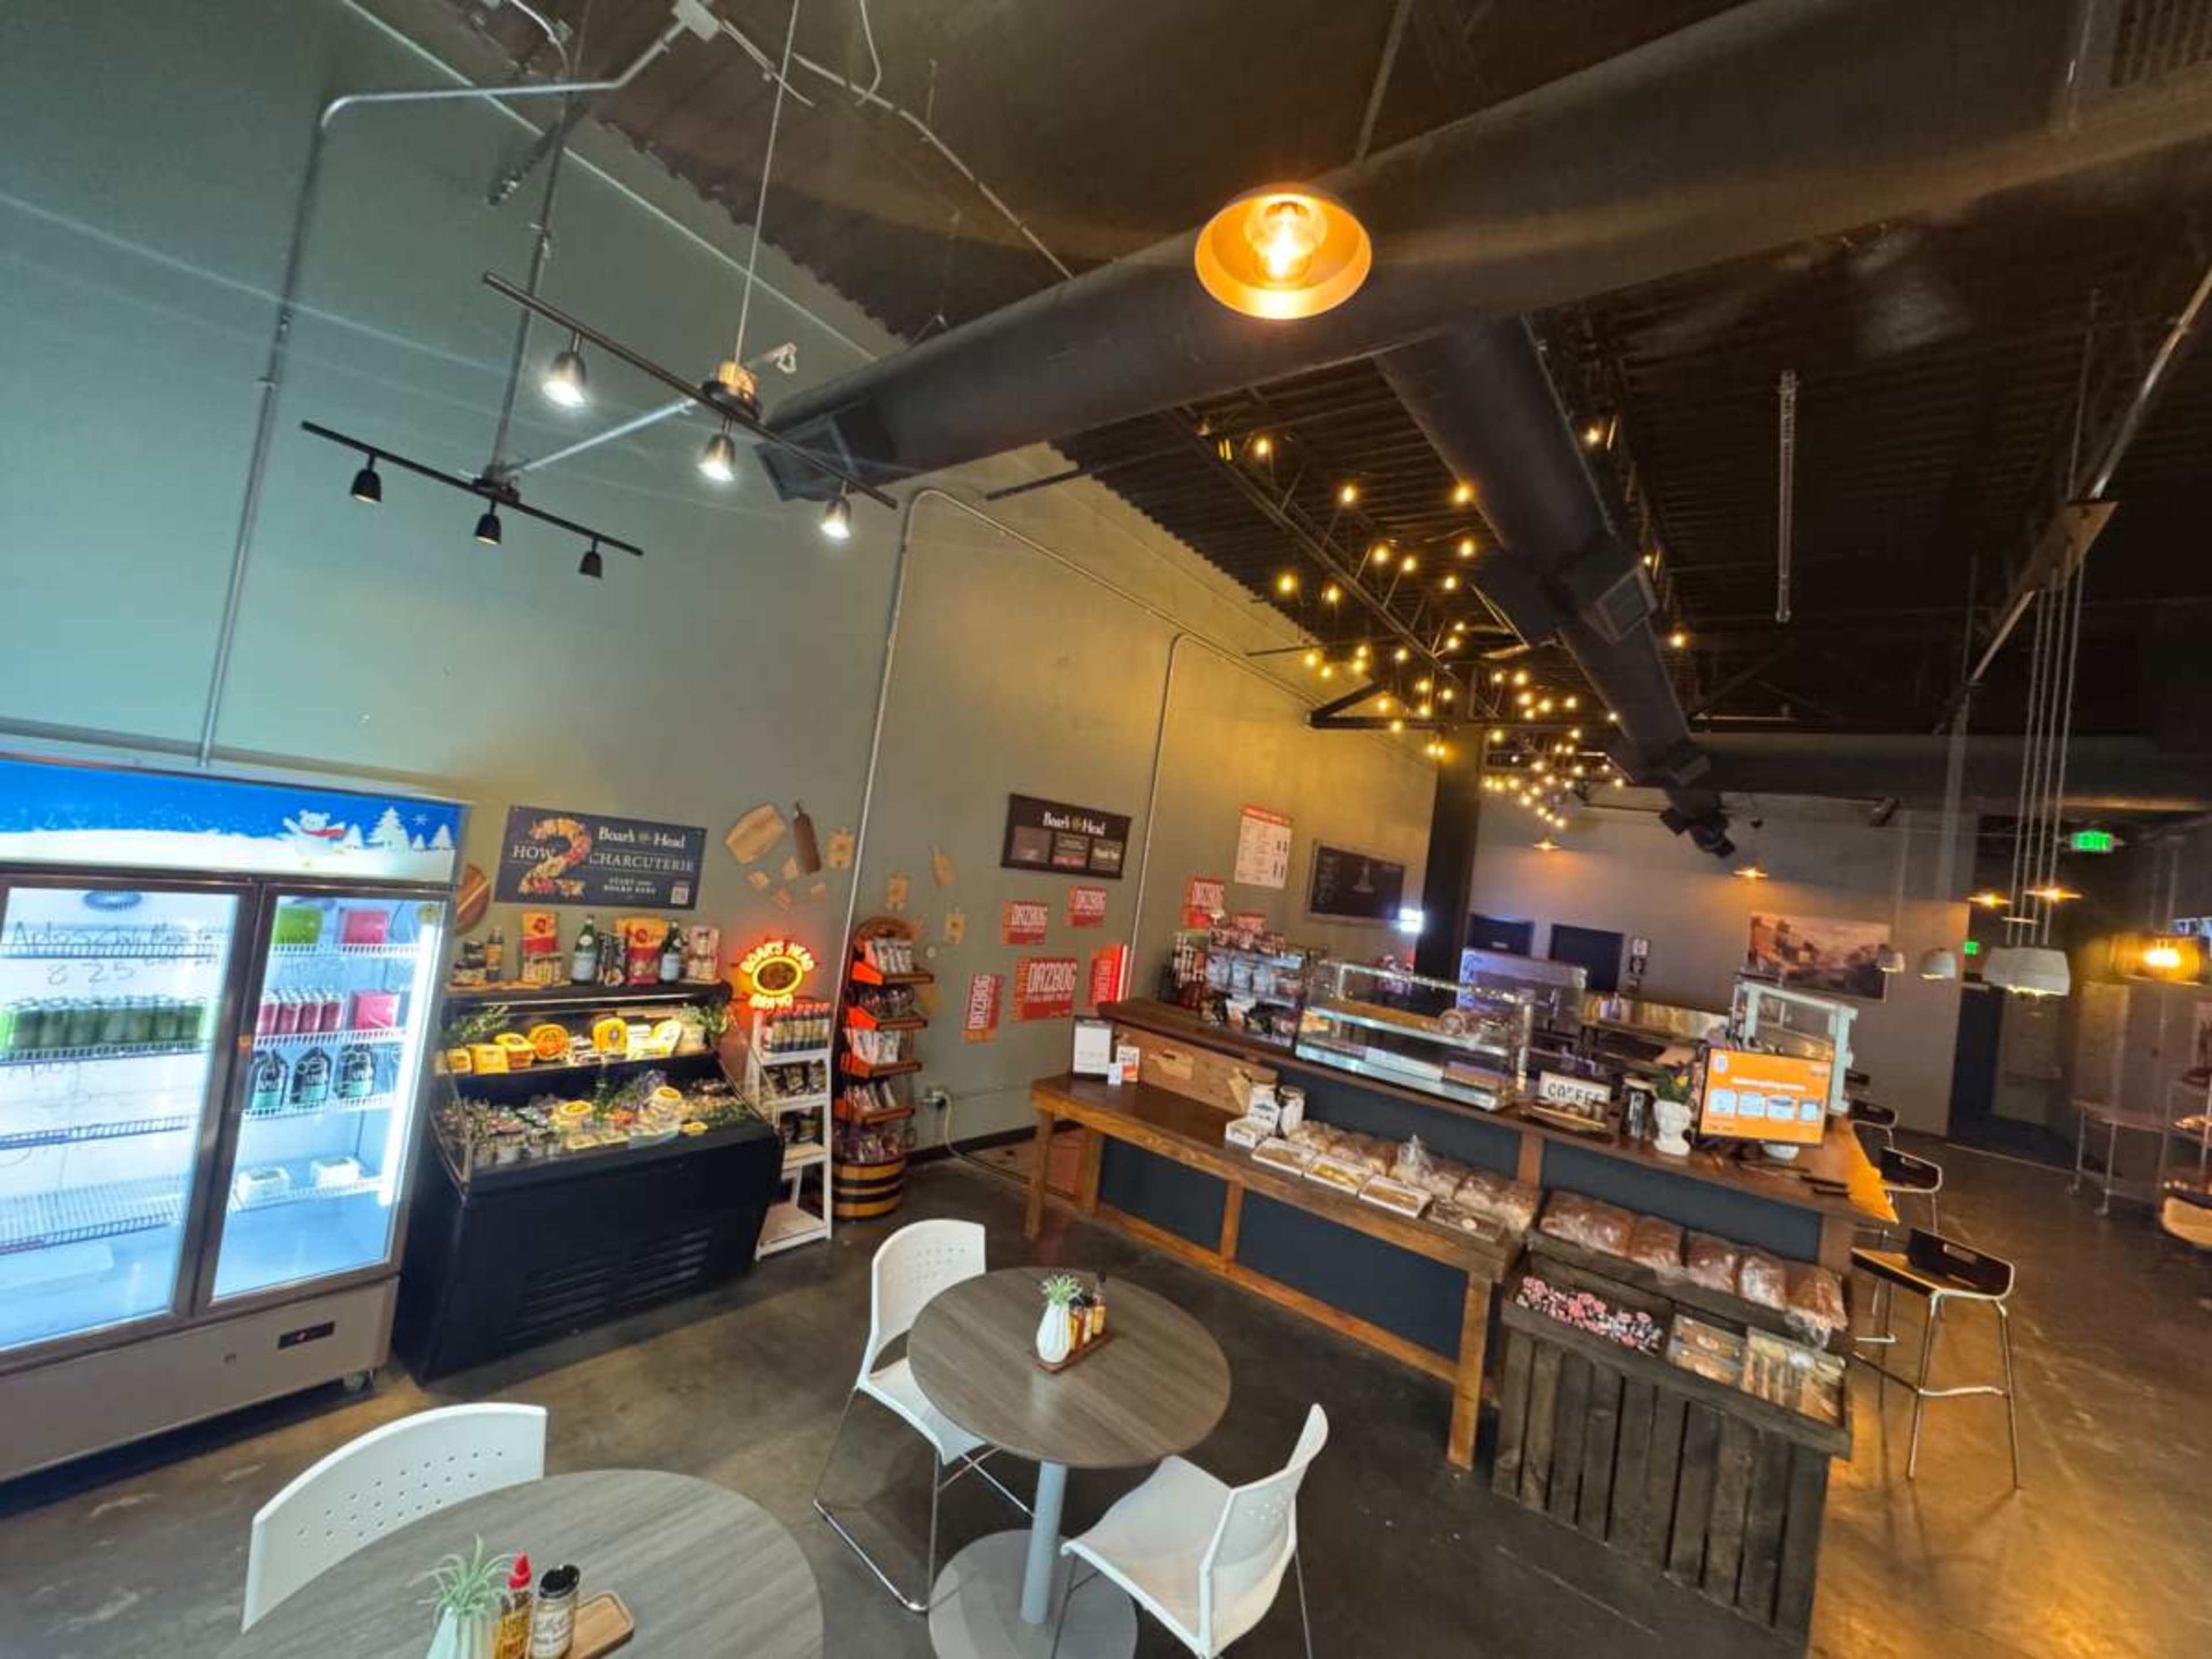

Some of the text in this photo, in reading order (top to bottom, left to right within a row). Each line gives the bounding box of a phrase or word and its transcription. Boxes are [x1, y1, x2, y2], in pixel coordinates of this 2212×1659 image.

[653, 832, 687, 849] Head
[513, 844, 555, 861] HOW
[589, 851, 695, 872] CHARCUTERIE
[1027, 962, 1077, 993] DAZBOG
[967, 974, 991, 1029] DAZBOG
